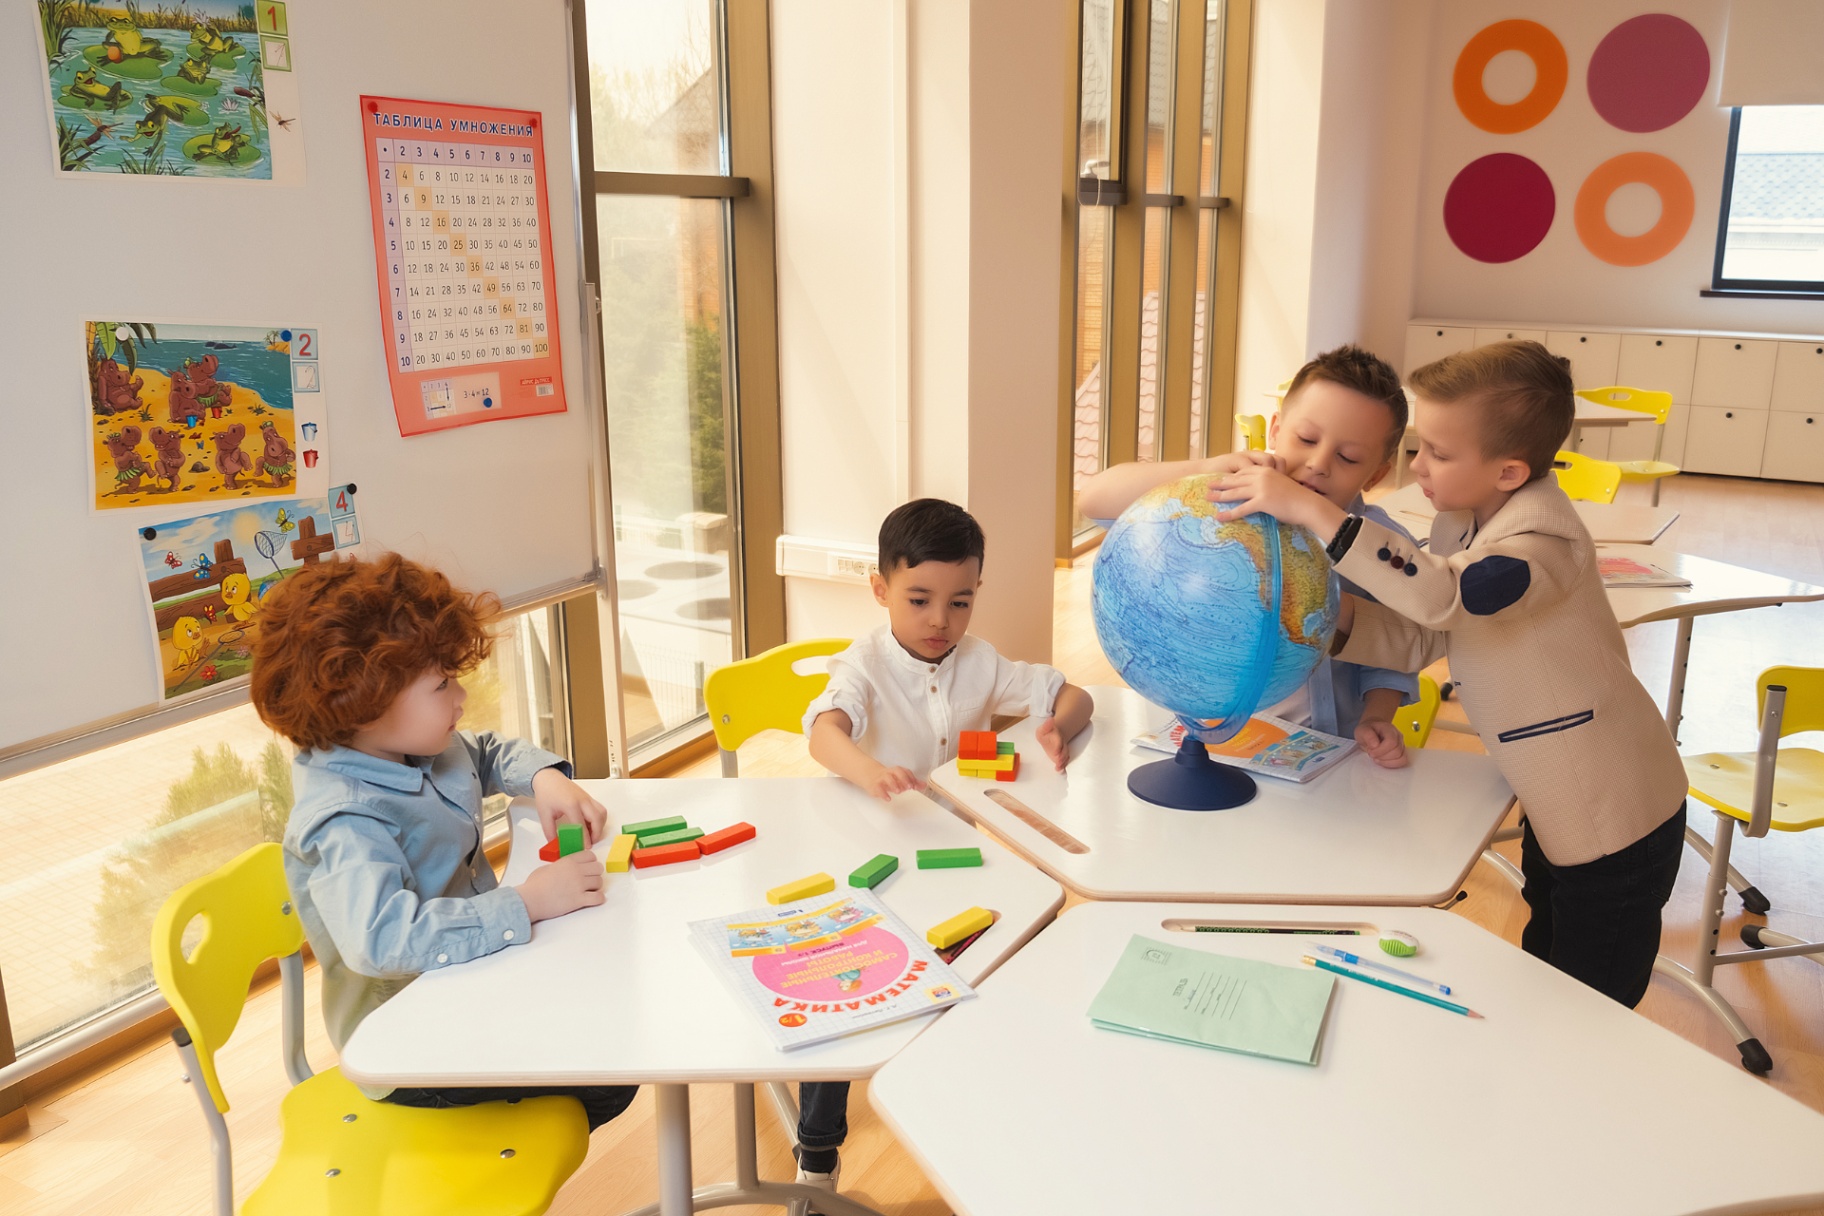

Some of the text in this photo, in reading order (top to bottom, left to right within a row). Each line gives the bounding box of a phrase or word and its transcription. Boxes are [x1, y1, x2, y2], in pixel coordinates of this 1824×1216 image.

[268, 5, 277, 31] 1
[374, 113, 533, 137] ТАБЛИЦА УМНОЖЕНИЯ
[399, 145, 531, 163] 2 3 4 5 6 7 8 9 10
[384, 168, 533, 184] 2 4 6 8 10 12 14 16 18 20
[386, 192, 534, 206] 3 6 9 12 15 18 21 24 27 30
[388, 216, 536, 227] 4 8 12 16 20 24 28 32 36 40
[390, 238, 537, 251] 5 10 15 20 25 30 35 40 45 50
[392, 260, 540, 274] 6 12 18 24 30 36 42 48 54 60
[394, 280, 541, 297] 7 14 21 28 35 42 49 56 63 70
[397, 301, 543, 320] 8 16 24 32 40 48 56 64 72 80
[399, 322, 545, 344] 9 18 27 36 45 54 63 72 81 90
[299, 333, 312, 356] 2
[400, 342, 548, 366] 10 20 30 40 50 60 70 80 90 100
[336, 491, 349, 512] 4
[786, 953, 871, 980] КОНТРОЛЬНЫЕ
[806, 951, 853, 967] РАБОТЫ
[780, 952, 897, 989] САМОСТОЯТЕЛЬНЫЕ
[774, 959, 929, 1013] МАТЕМАТИКА
